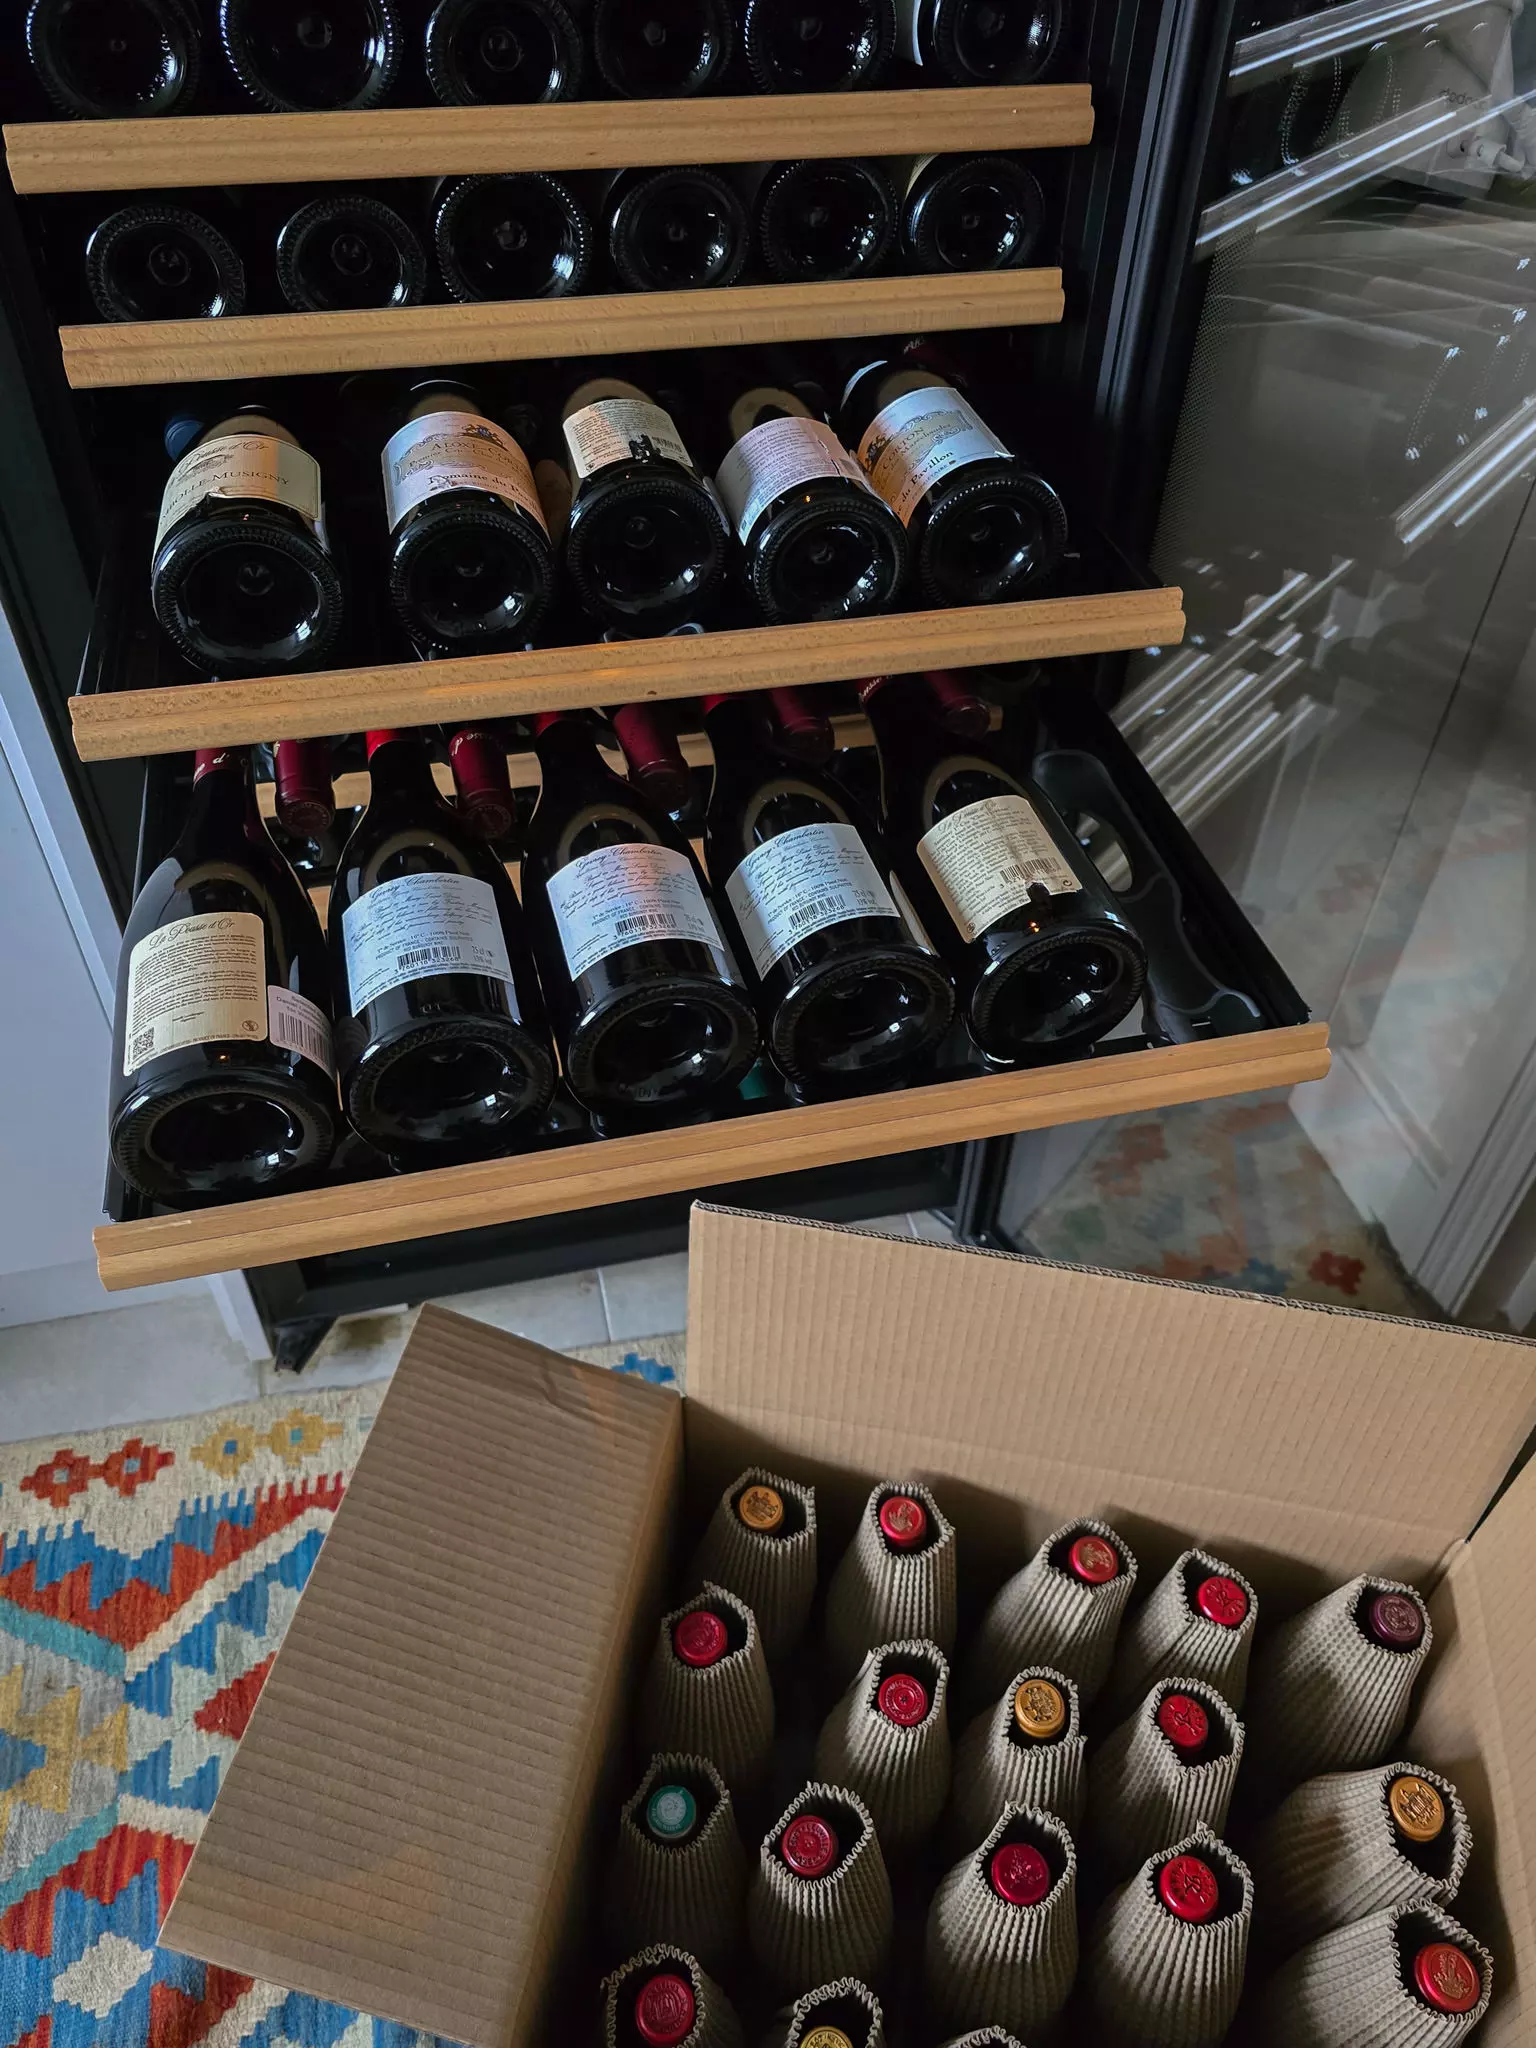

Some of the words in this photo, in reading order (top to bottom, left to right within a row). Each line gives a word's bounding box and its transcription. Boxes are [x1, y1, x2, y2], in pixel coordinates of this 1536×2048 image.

[883, 427, 925, 470] CORTON
[910, 451, 955, 486] Pavillon
[575, 847, 662, 871] Gevrey-Chambertin
[745, 828, 824, 868] Gevrey-Chambertin
[370, 875, 460, 902] Gevrey-Chambertin
[149, 933, 166, 950] La
[169, 922, 208, 942] Pousse
[209, 917, 236, 931] d'Or
